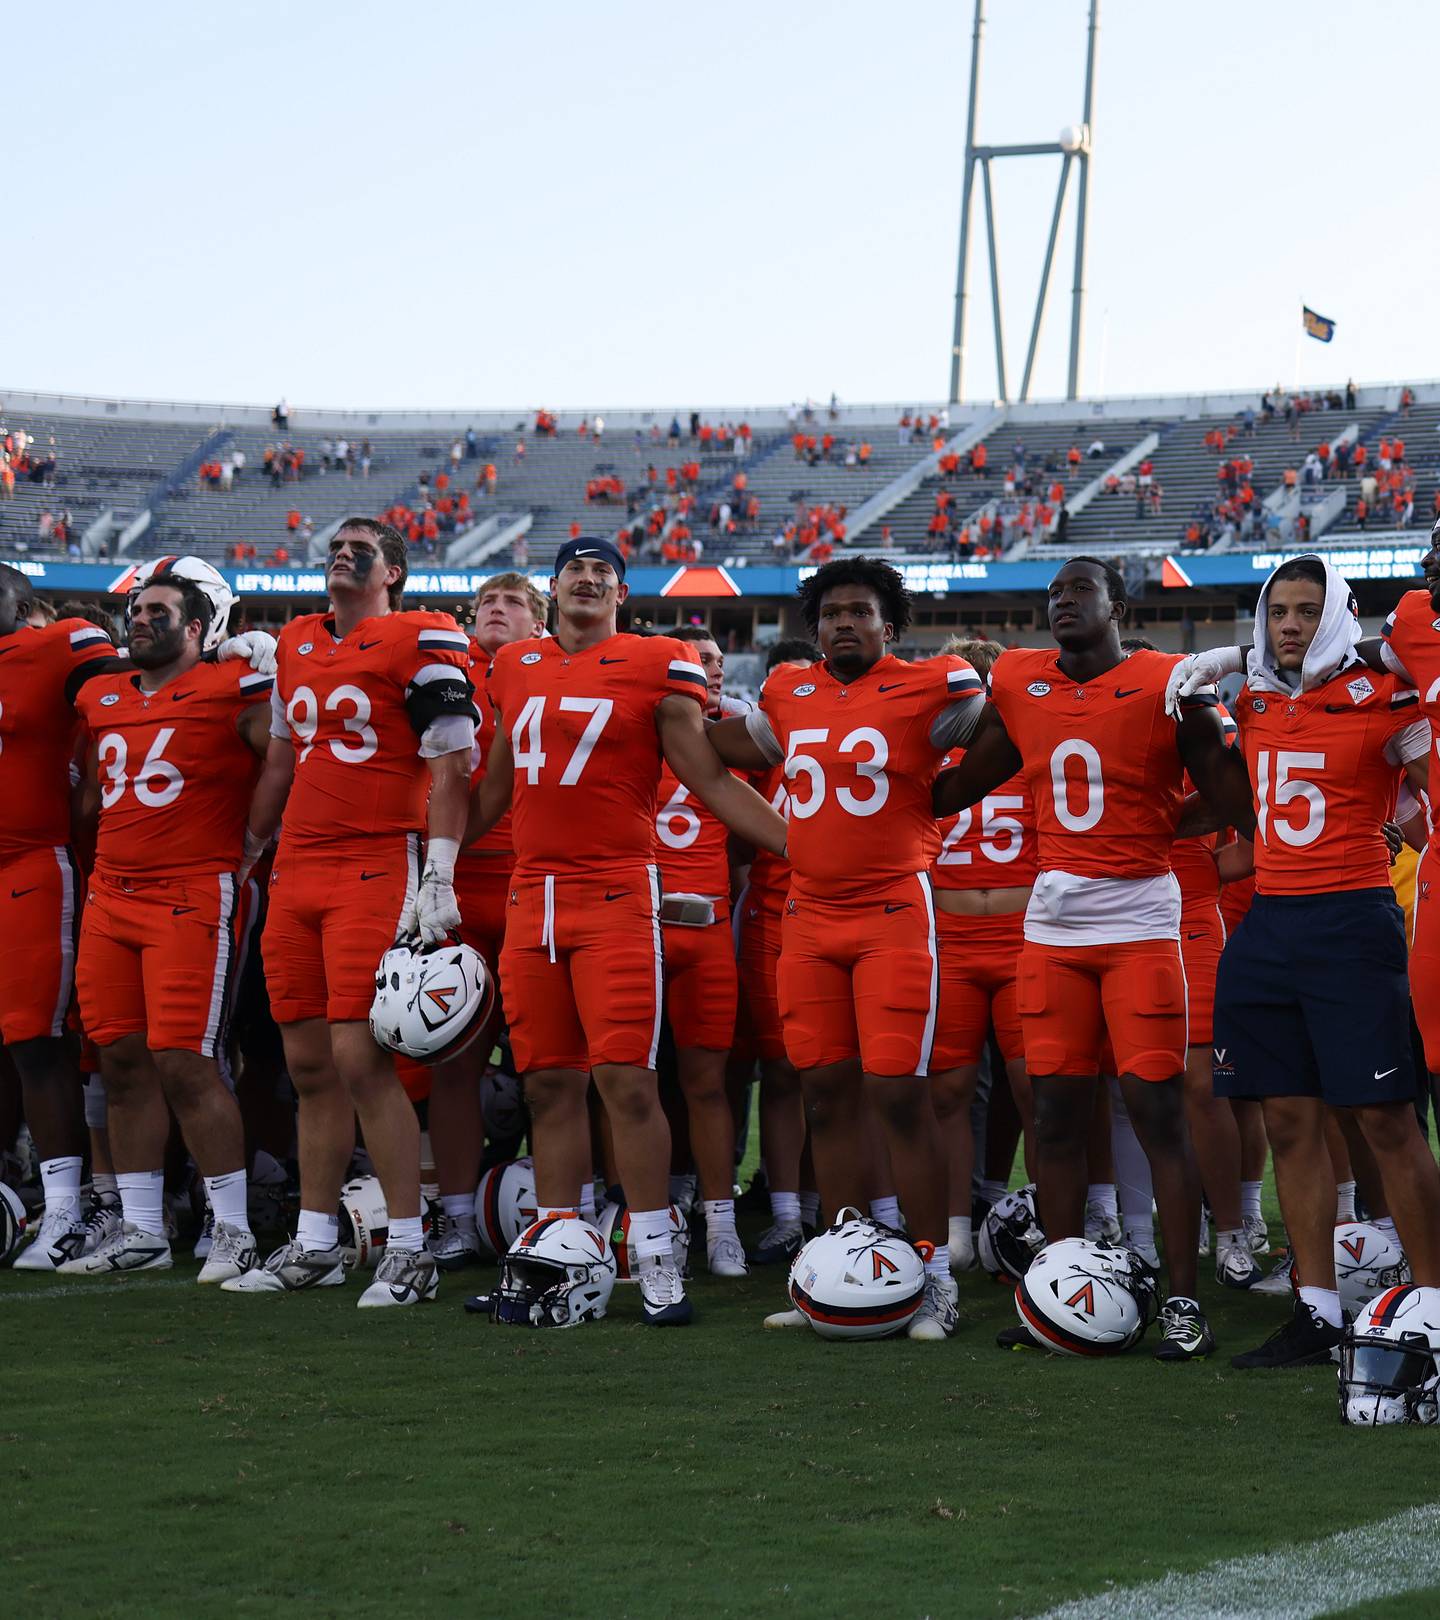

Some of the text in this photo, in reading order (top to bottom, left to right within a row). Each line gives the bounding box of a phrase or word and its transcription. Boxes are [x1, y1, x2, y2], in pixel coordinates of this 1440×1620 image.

[236, 574, 272, 591] LET'S
[272, 575, 295, 591] ALL
[440, 576, 471, 592] YELL
[286, 684, 379, 766] 93
[1031, 684, 1048, 692] ACC
[98, 727, 185, 808] 36
[512, 695, 614, 786] 47
[785, 727, 890, 819] 53
[1049, 738, 1104, 832] 0
[1257, 751, 1327, 847] 15
[936, 796, 1024, 866] 25
[424, 986, 458, 1016] V
[1338, 1237, 1366, 1265] V
[1364, 1327, 1388, 1336] ACC
